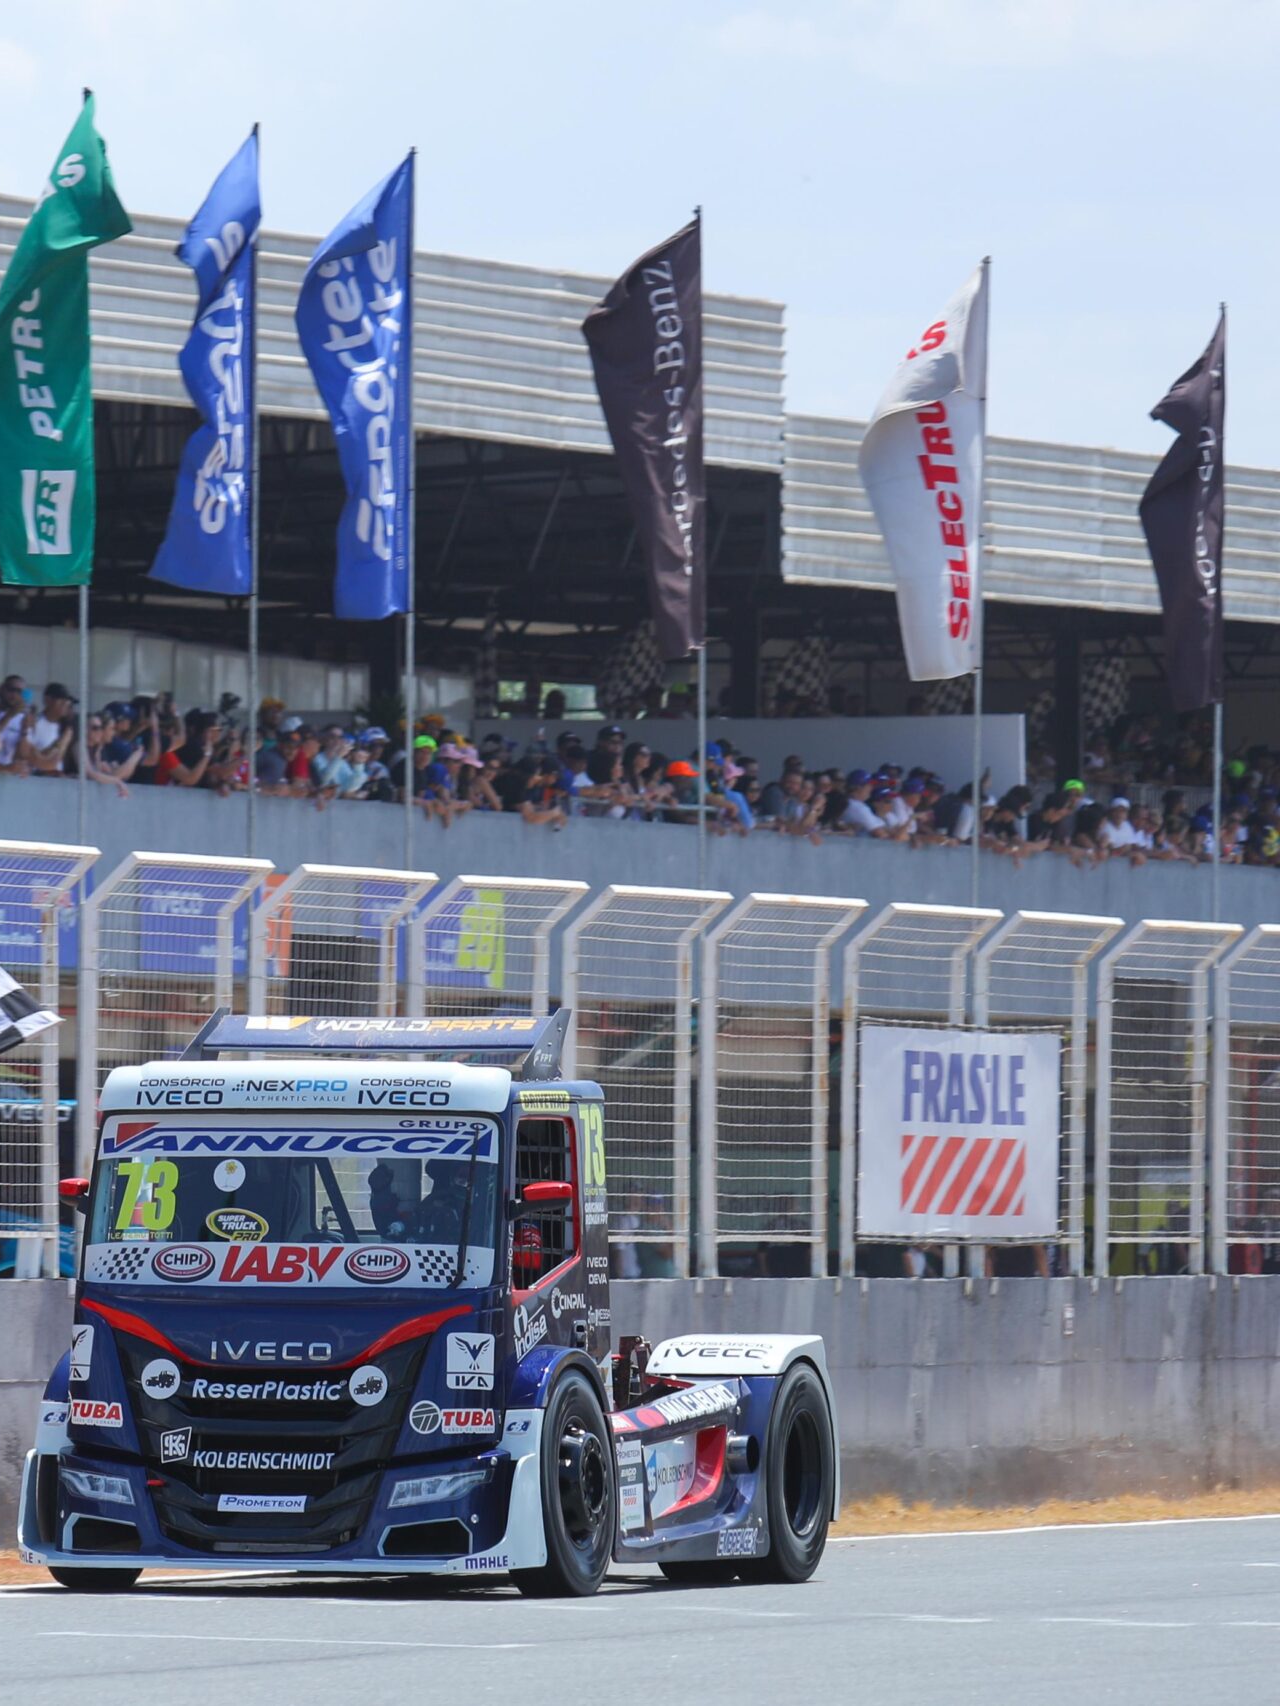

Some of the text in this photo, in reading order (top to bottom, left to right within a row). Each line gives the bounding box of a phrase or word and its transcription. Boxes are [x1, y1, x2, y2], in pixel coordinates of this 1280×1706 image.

[36, 478, 63, 546] BR
[540, 1053, 552, 1063] FPT
[139, 1077, 226, 1088] CONSÓRCIO
[245, 1079, 348, 1092] NEXPRO
[359, 1077, 452, 1088] CONSÓRCIO
[136, 1090, 223, 1106] IVECO
[245, 1095, 347, 1103] AUTHENTIC VALUE
[357, 1090, 450, 1106] IVECO
[399, 1119, 488, 1131] GRUPO
[103, 1126, 494, 1157] VANNUCCI
[115, 1160, 179, 1231] 73
[218, 1214, 246, 1223] SUPER
[221, 1221, 258, 1230] TRUCK
[150, 1231, 173, 1240] TOTTI
[233, 1232, 261, 1241] PRO
[164, 1253, 203, 1266] CHIPI
[356, 1254, 398, 1267] CHIPI
[586, 1256, 608, 1269] IVECO
[588, 1273, 608, 1285] DEVA
[559, 1293, 587, 1311] CINPAL
[513, 1313, 548, 1361] indisa
[210, 1340, 332, 1361] IVECO
[663, 1347, 769, 1360] IVECO
[455, 1375, 489, 1388] IVA
[72, 1402, 122, 1421] TUBA
[442, 1411, 494, 1427] TUBA
[193, 1450, 335, 1470] KOLBENSCHMIDT
[223, 1496, 302, 1508] PROMETEON
[464, 1554, 509, 1569] MAHLE
